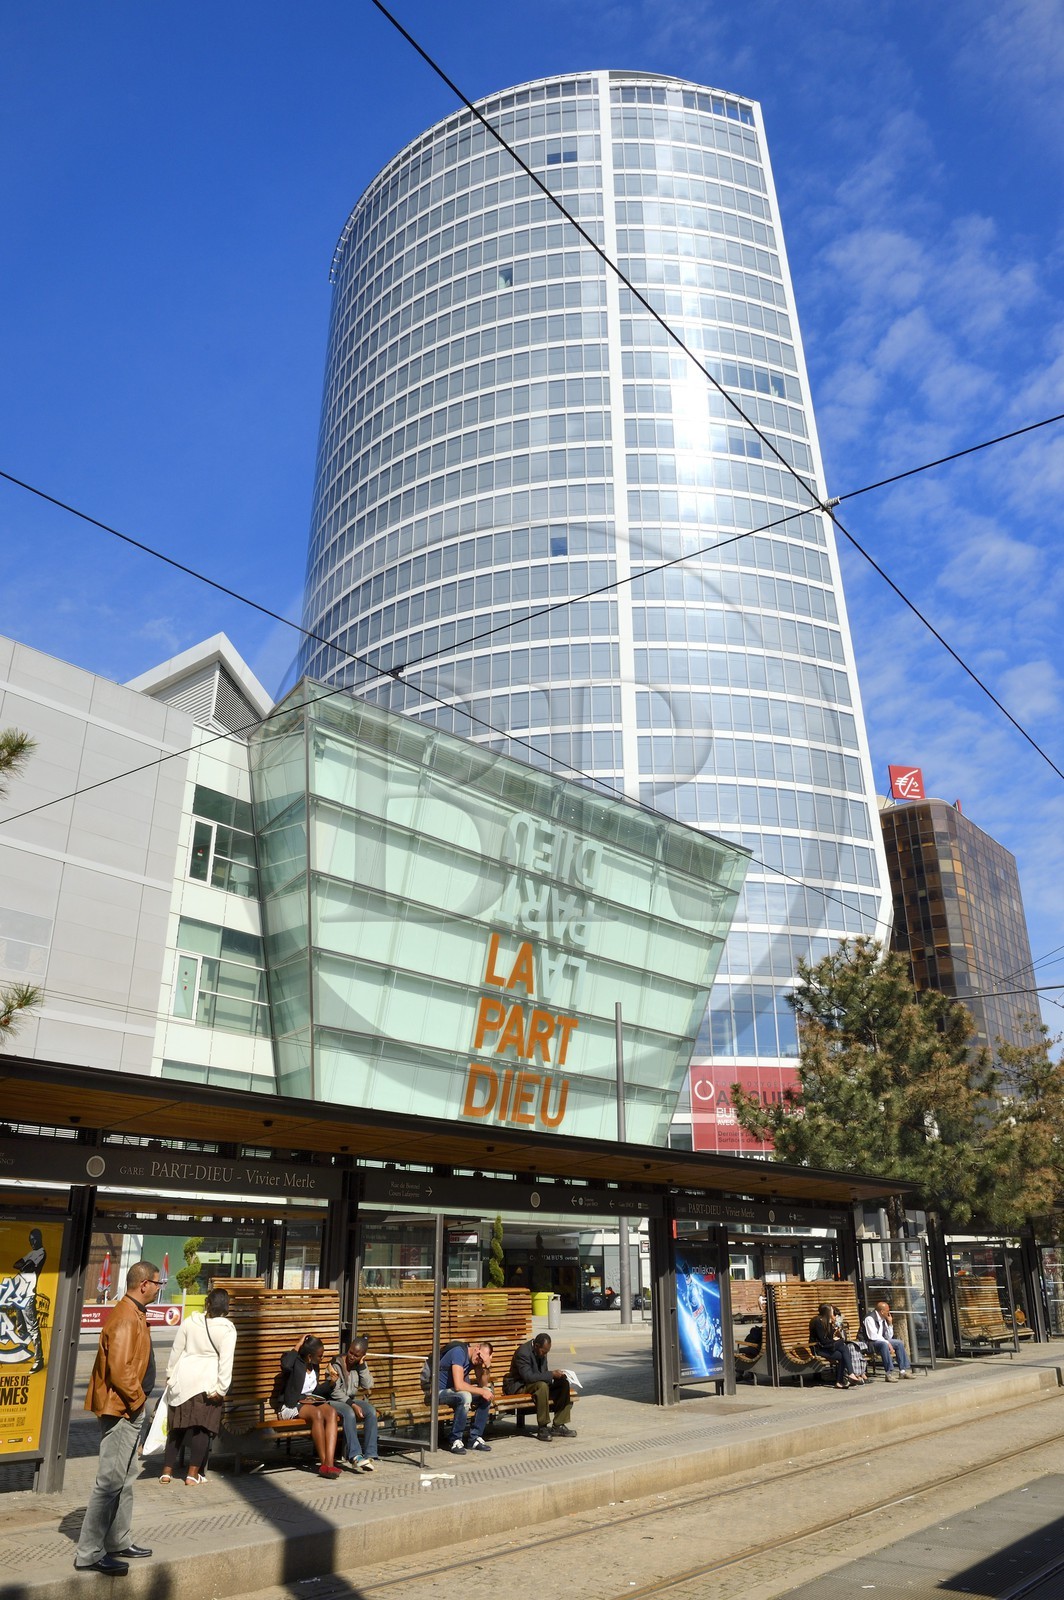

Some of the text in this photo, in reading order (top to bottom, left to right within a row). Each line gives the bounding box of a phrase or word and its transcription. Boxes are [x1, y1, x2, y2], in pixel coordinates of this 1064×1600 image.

[484, 932, 535, 995] LA
[473, 997, 579, 1066] PART
[462, 1062, 570, 1129] DIEU
[119, 1165, 145, 1176] GARE
[151, 1161, 234, 1183] PART-DIEU
[246, 1169, 281, 1187] Vivier
[283, 1172, 316, 1189] Merle
[688, 1203, 721, 1216] PART-DIEU
[725, 1206, 740, 1217] Vivier
[741, 1207, 755, 1218] Merle
[20, 1375, 31, 1387] DE
